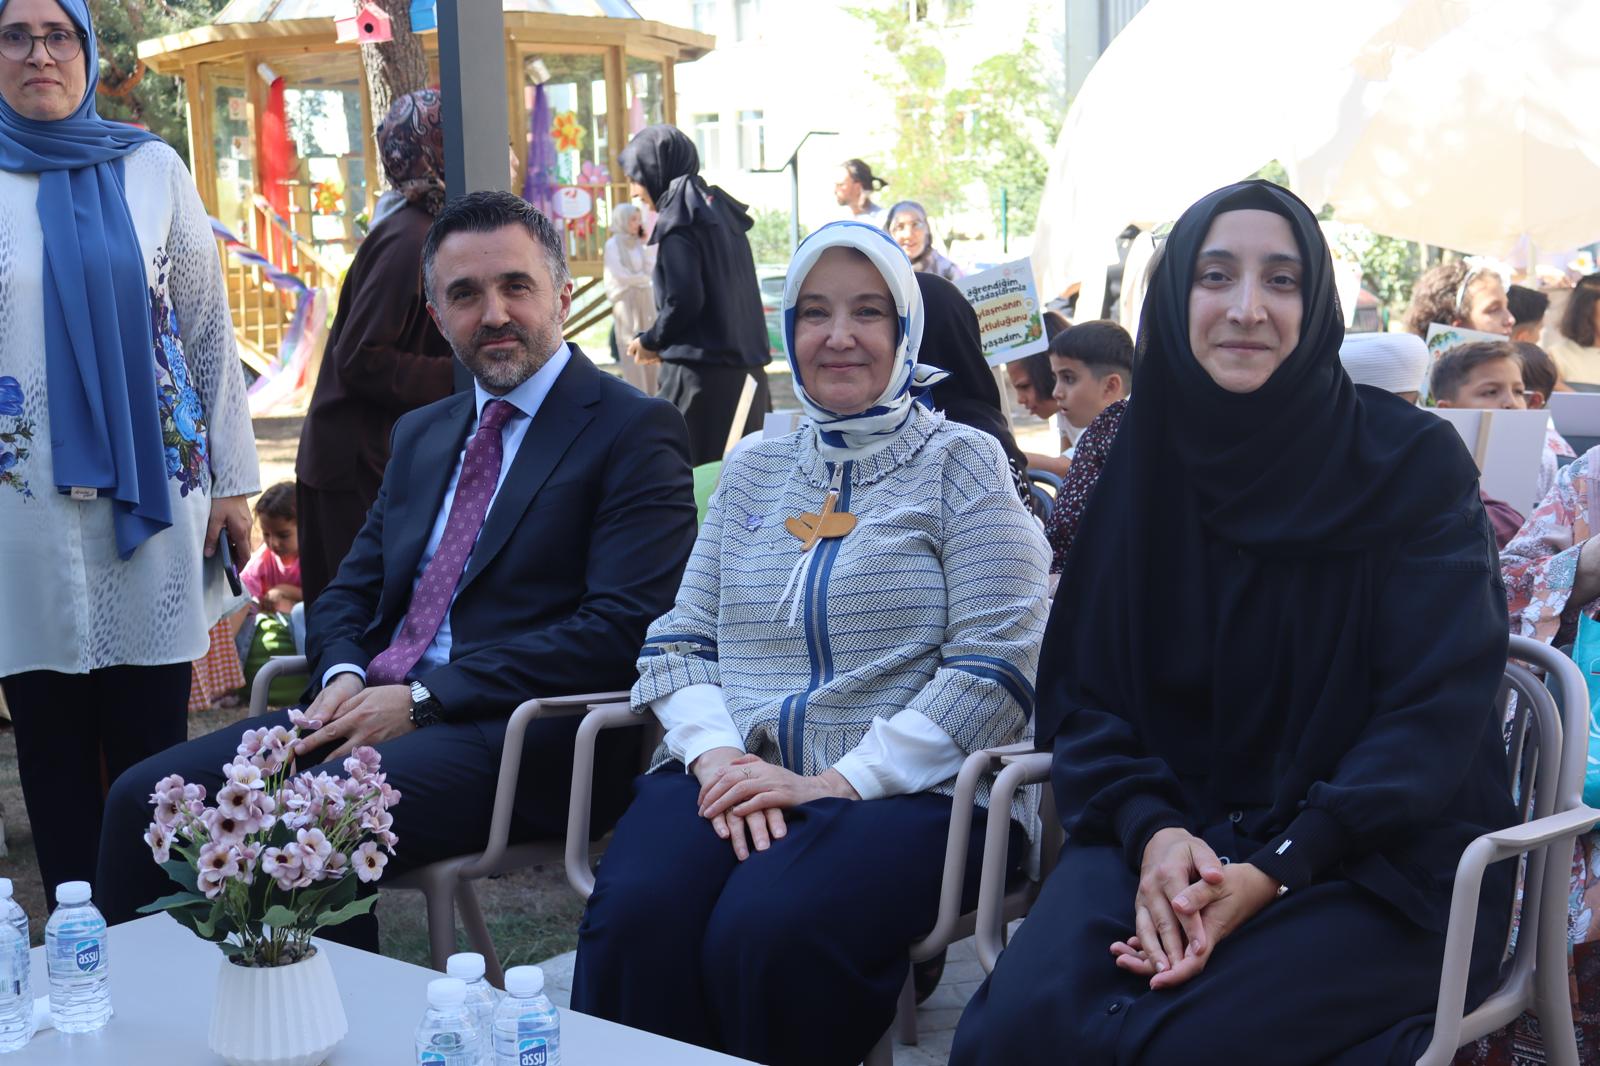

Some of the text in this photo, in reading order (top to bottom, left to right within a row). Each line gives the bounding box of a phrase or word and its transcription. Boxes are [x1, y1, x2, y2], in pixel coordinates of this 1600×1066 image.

[977, 299, 1022, 320] ylaşmanın
[980, 313, 1028, 333] utluluğunu
[983, 332, 1023, 351] yaşadım.
